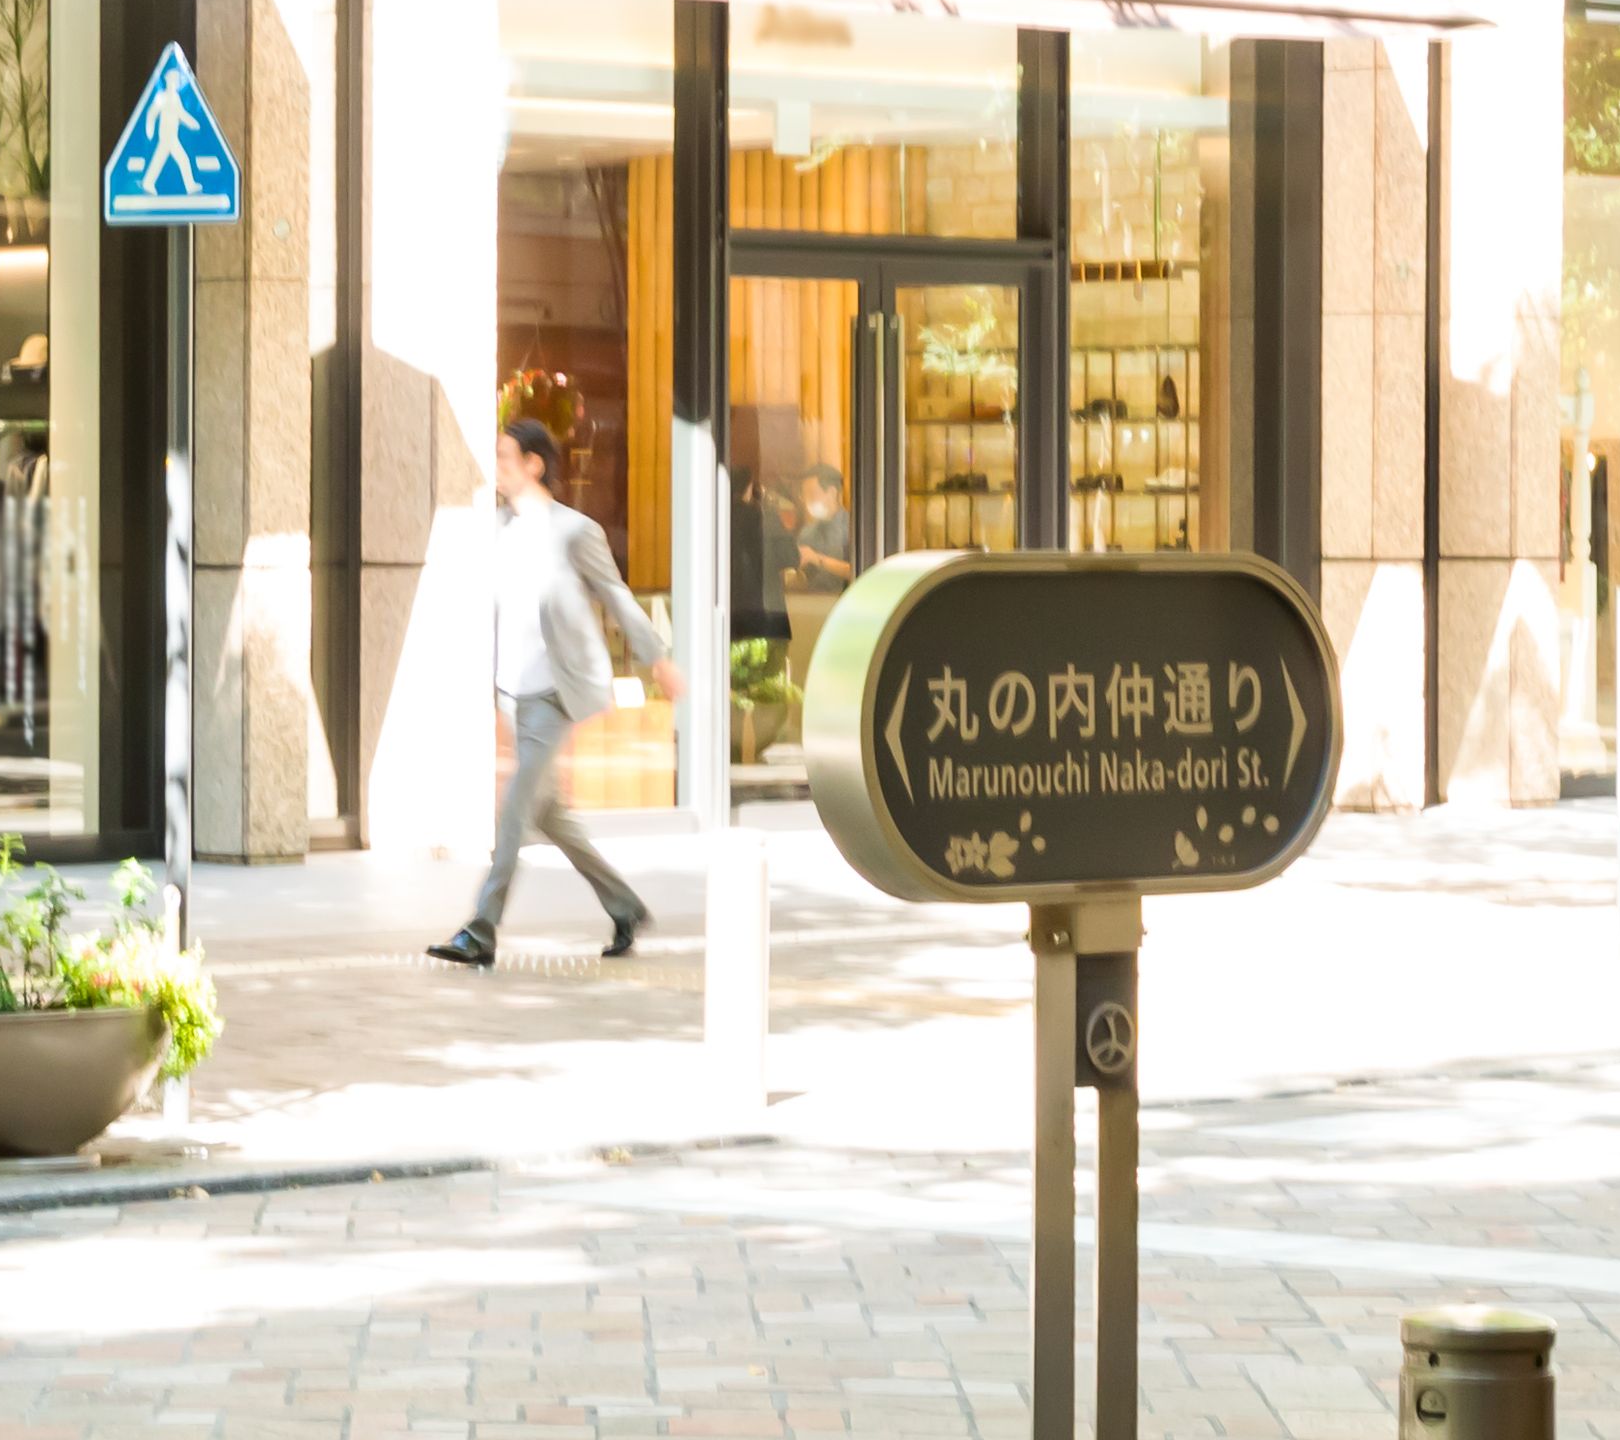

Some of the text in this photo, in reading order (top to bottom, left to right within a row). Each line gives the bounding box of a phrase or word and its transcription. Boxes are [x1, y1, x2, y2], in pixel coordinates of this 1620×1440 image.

[926, 661, 1262, 743] 丸の内仲通り
[928, 746, 1270, 800] Marunouchi Naka-dori St.
